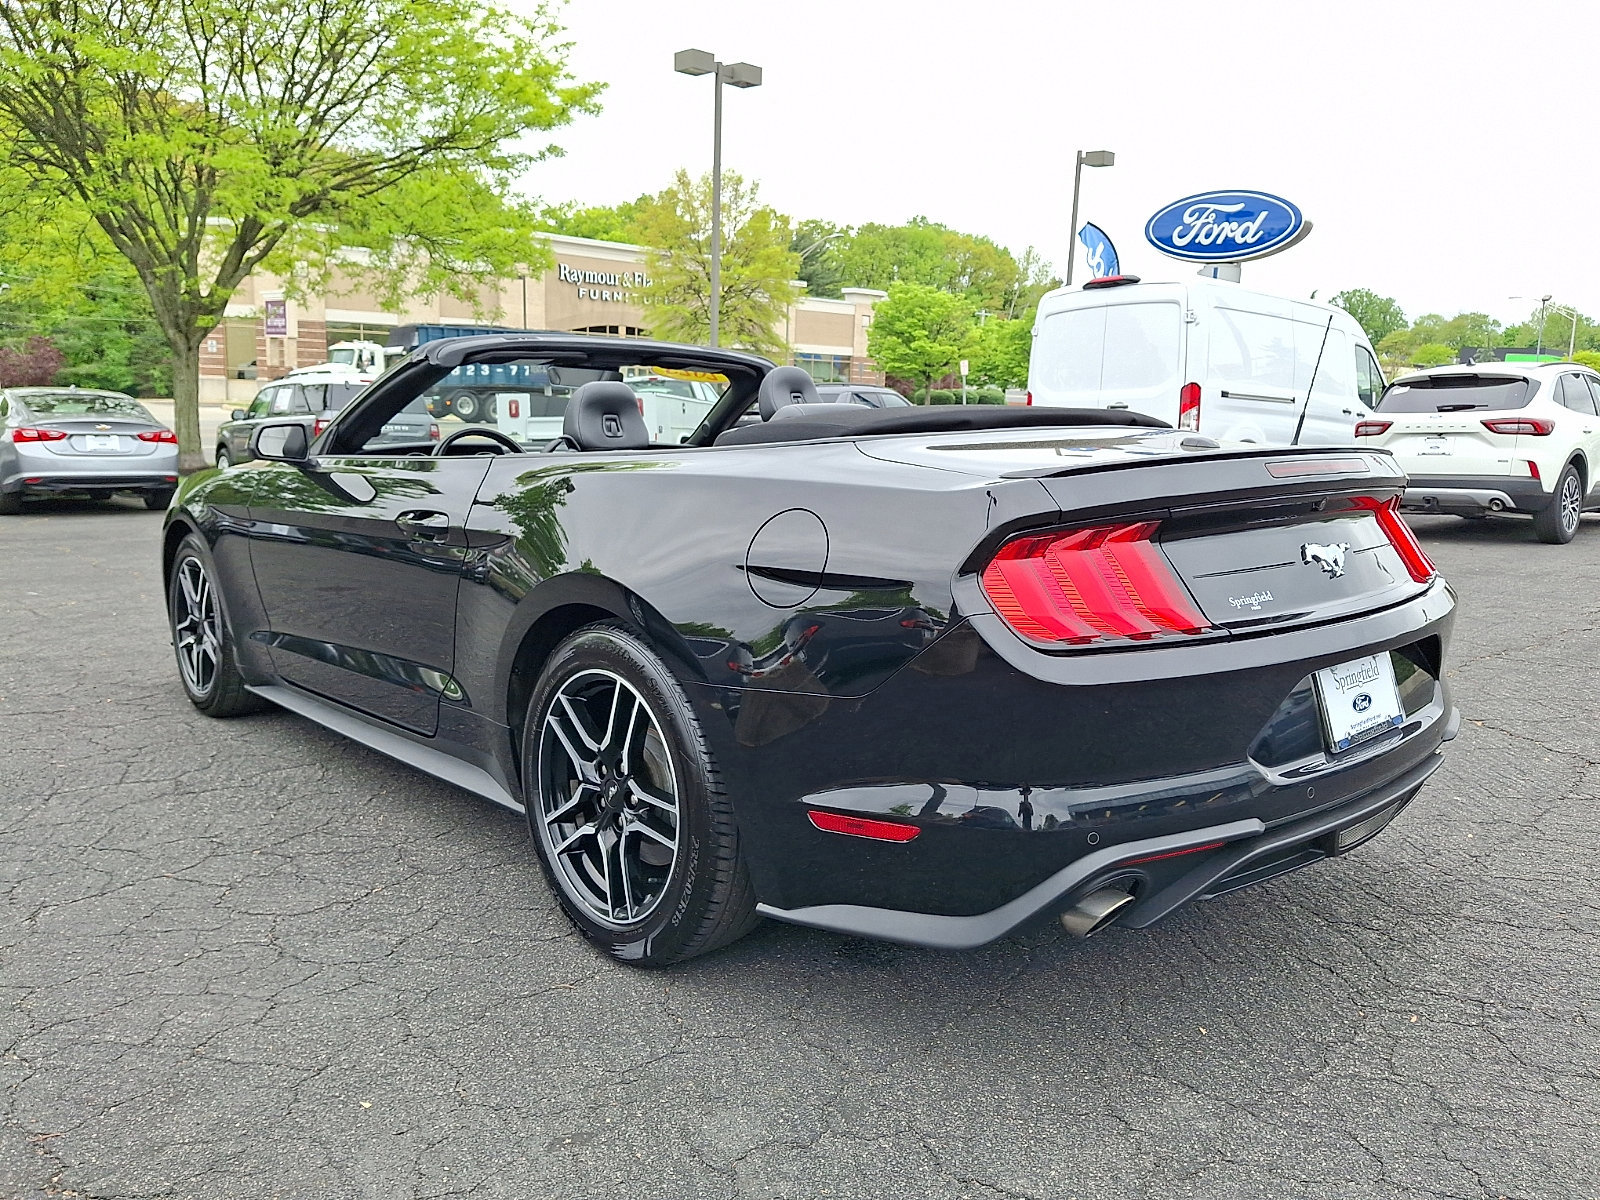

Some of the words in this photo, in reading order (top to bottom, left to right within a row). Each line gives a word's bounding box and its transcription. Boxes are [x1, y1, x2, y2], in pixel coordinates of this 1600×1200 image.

[1172, 202, 1269, 247] Ford
[559, 263, 621, 286] Raymour
[622, 271, 632, 288] &
[1228, 590, 1274, 609] Springfield
[1330, 654, 1380, 694] Springfield
